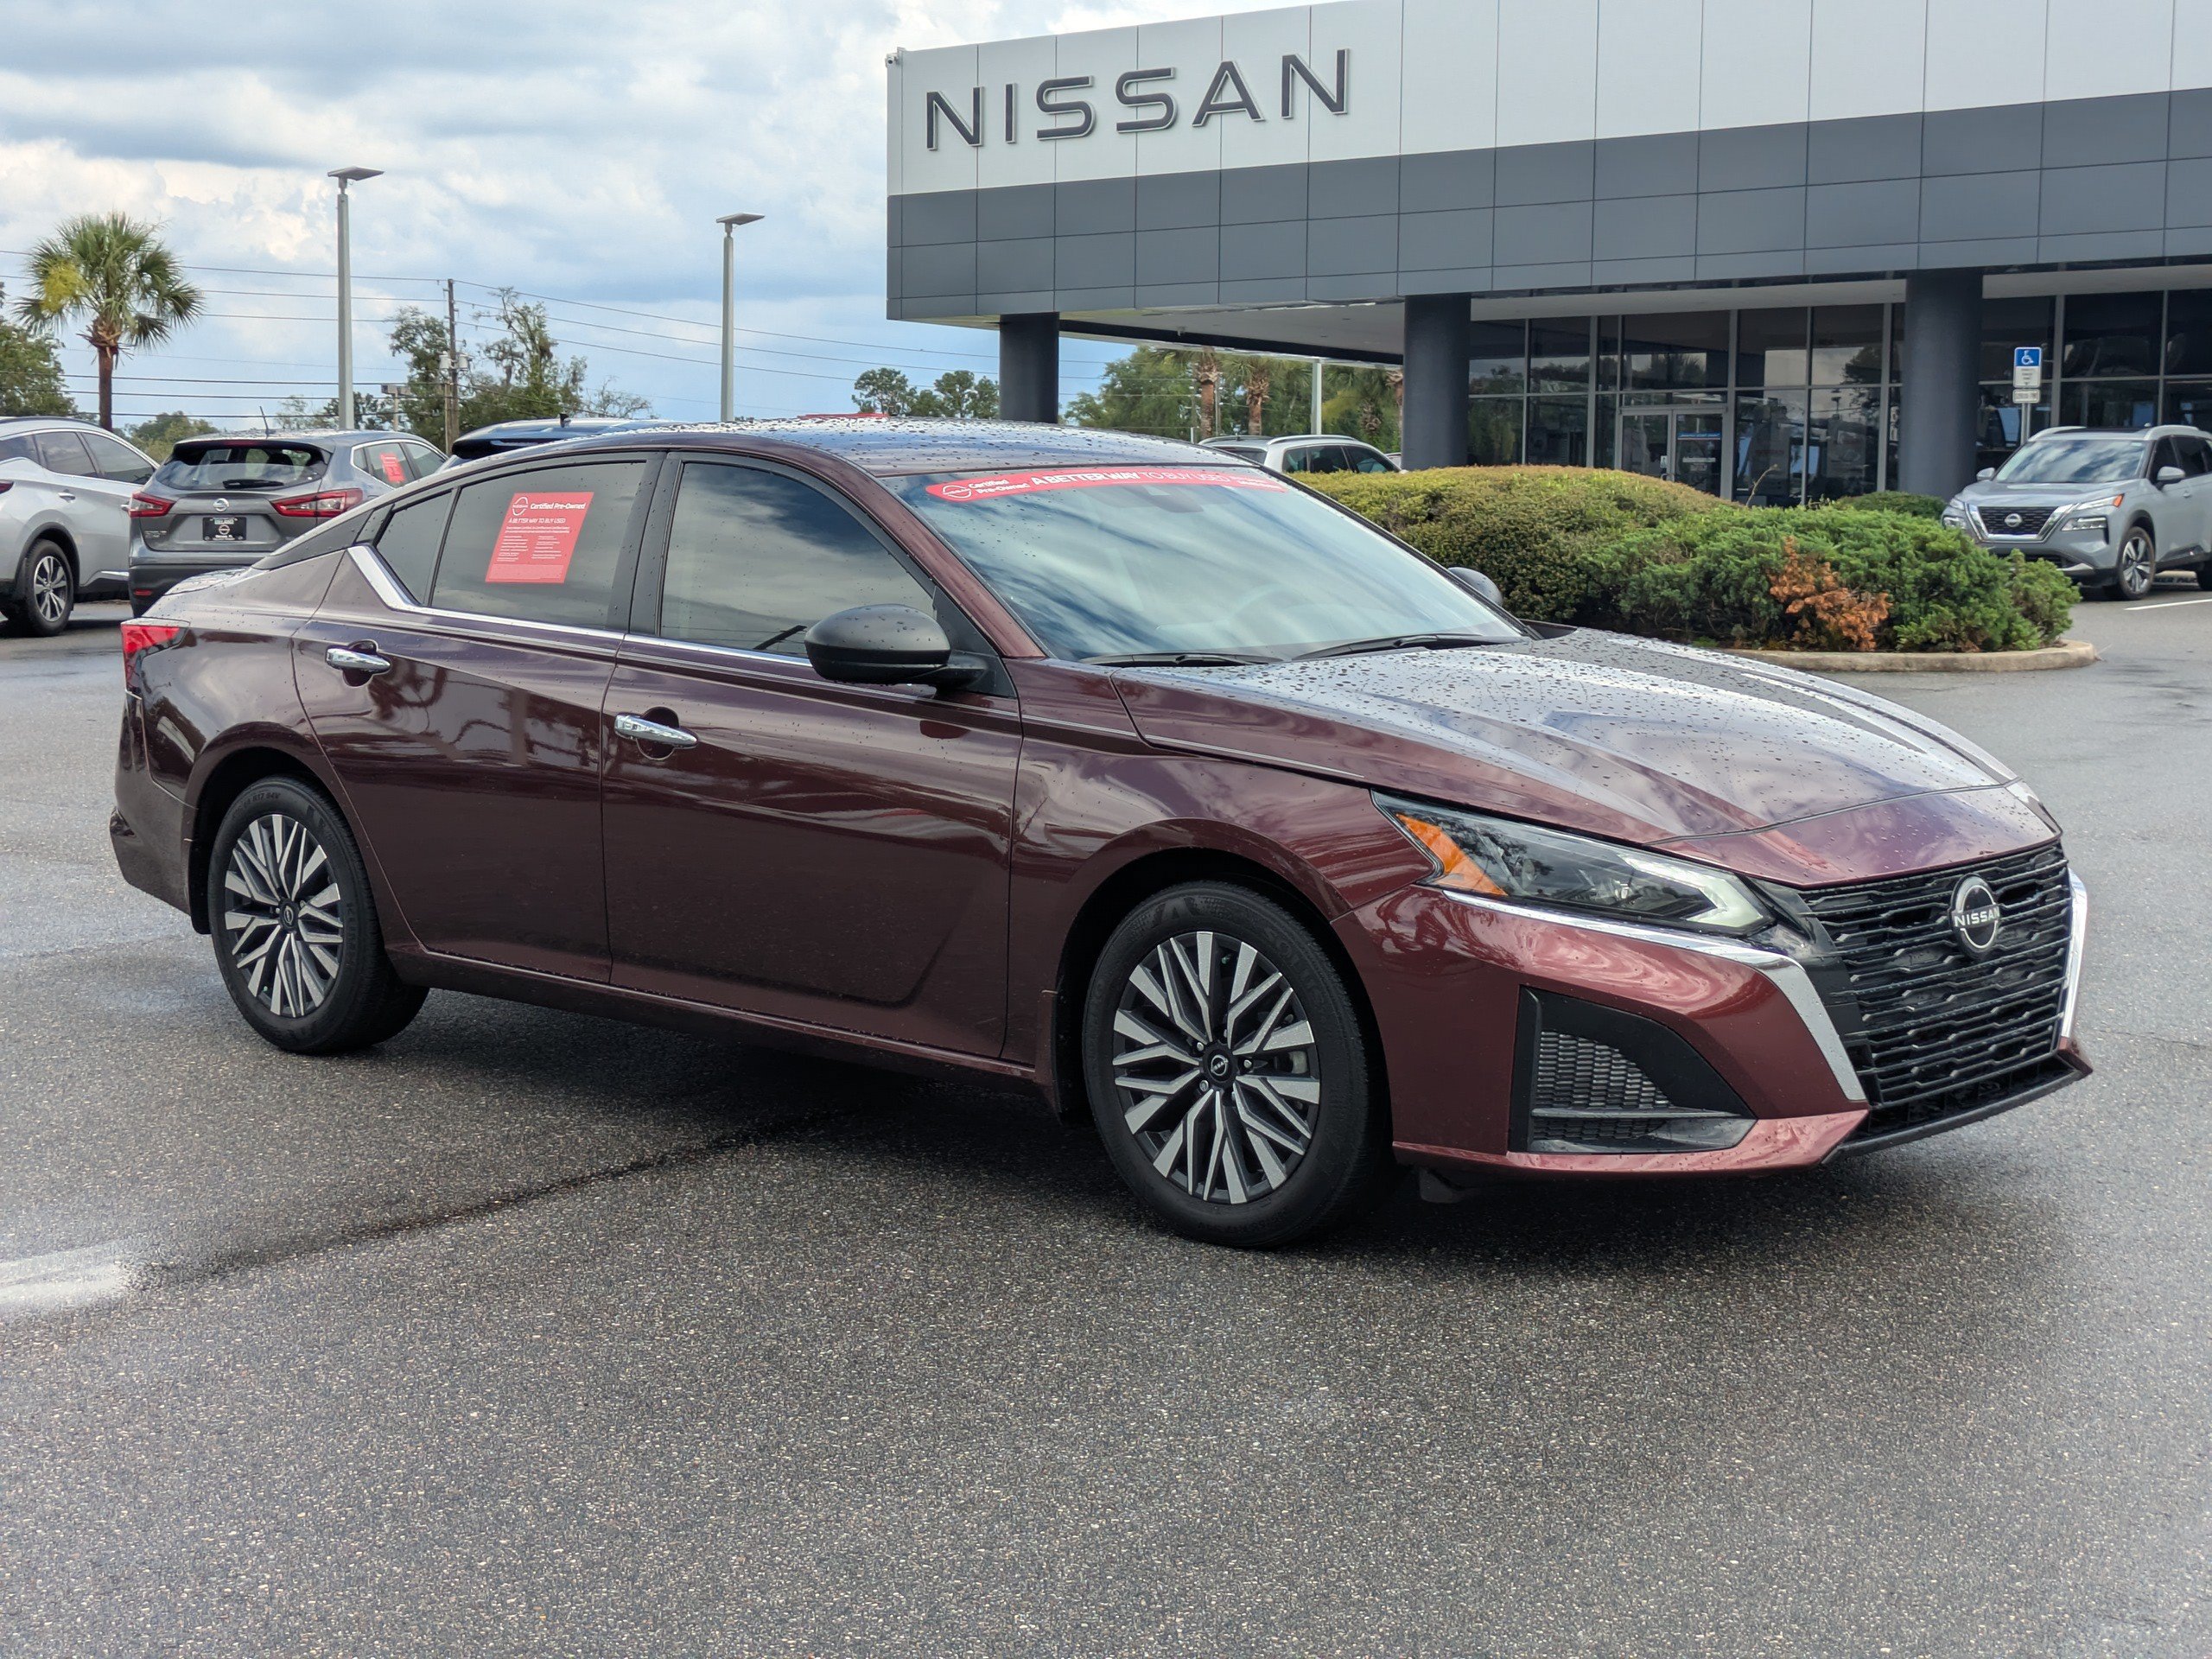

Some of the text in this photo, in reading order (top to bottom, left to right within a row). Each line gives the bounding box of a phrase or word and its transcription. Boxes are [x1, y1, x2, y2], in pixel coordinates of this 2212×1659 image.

[926, 48, 1350, 151] NISSAN
[968, 480, 1009, 489] Certified
[1032, 476, 1047, 486] A
[1046, 473, 1108, 485] BETTER
[1107, 471, 1141, 480] WAY
[1164, 471, 1192, 480] BUY
[976, 482, 1031, 493] Pre-Owned
[1955, 906, 2000, 927] NISSAN
